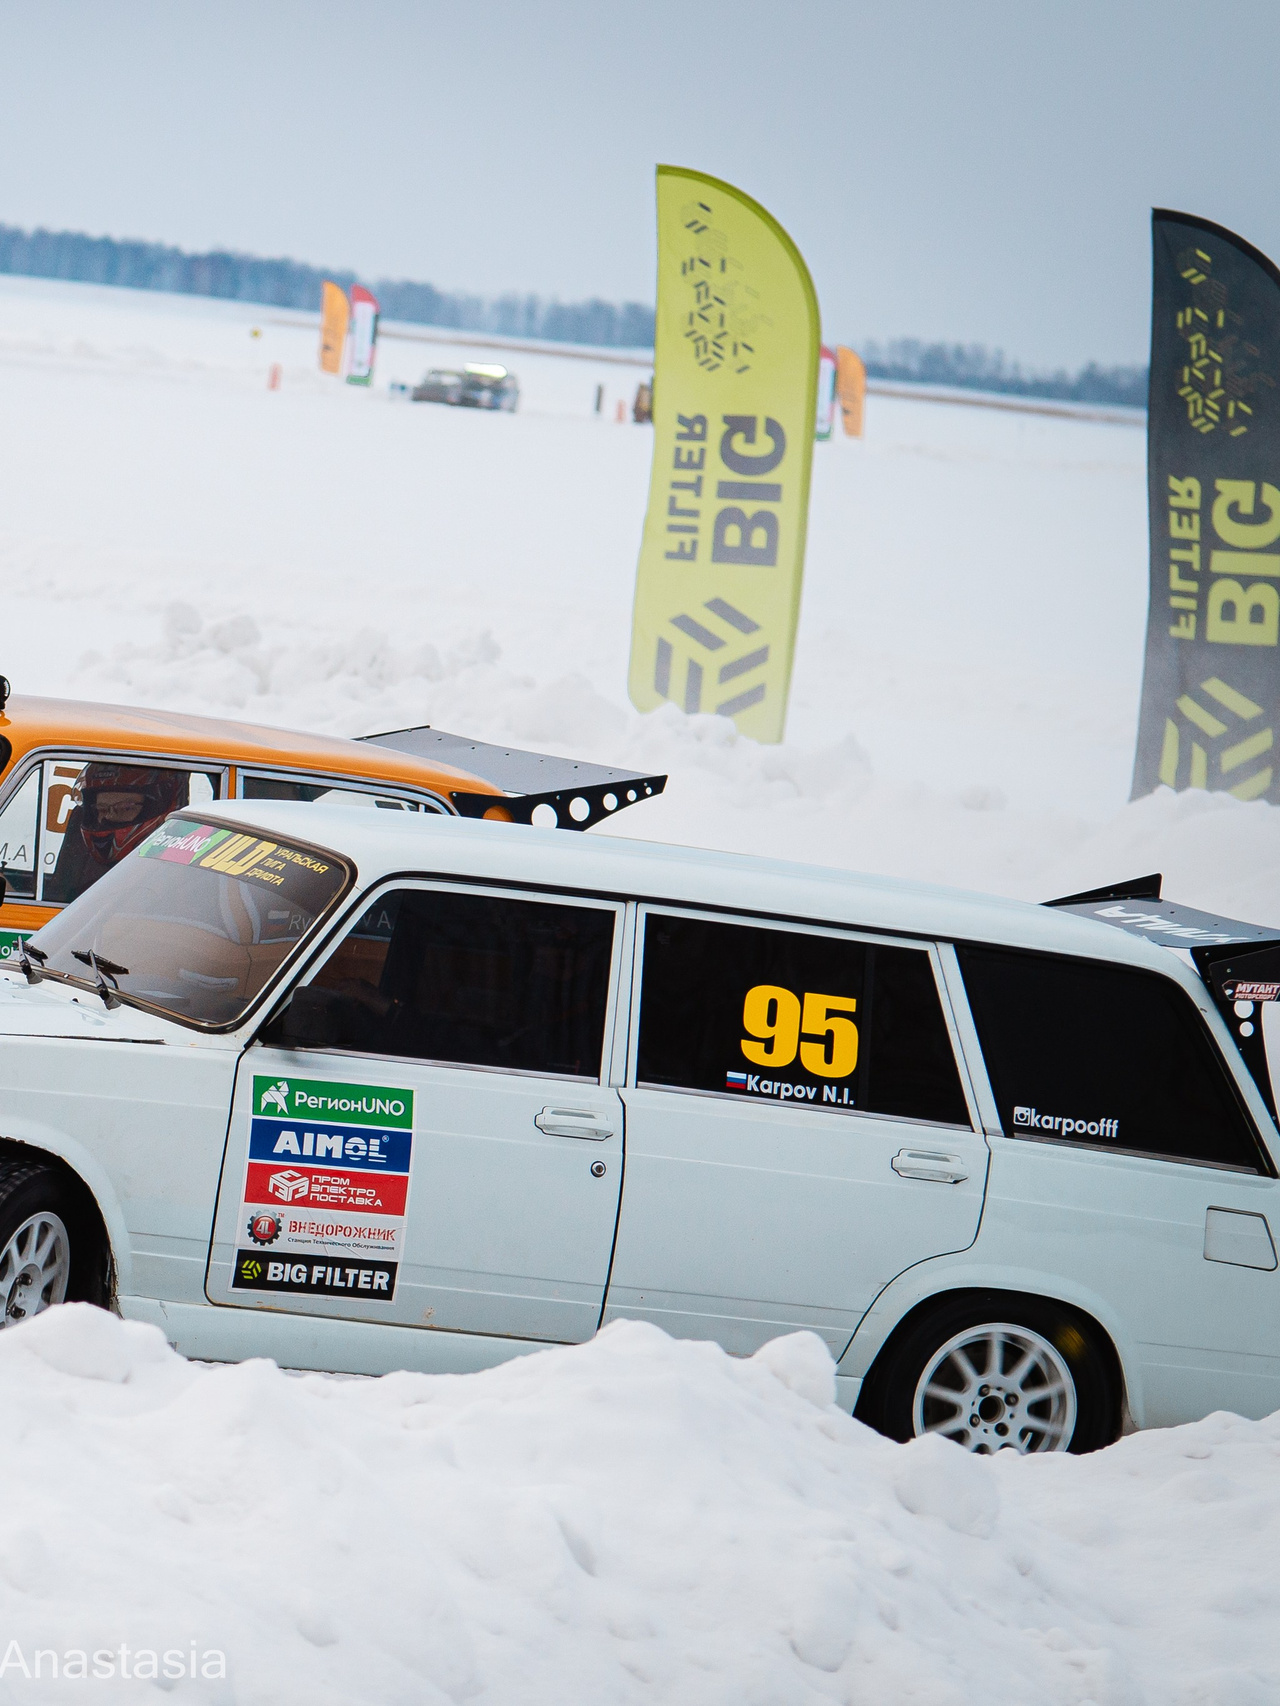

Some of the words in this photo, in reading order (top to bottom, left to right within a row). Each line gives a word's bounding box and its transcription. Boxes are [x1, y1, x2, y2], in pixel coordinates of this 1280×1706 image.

[260, 857, 287, 871] ЛИГА
[274, 848, 329, 874] УРАЛЬСКАЯ
[244, 867, 285, 886] ДРИФТА
[1235, 983, 1280, 994] МУТАНТ
[740, 984, 859, 1079] 95
[747, 1074, 818, 1100] Karpov
[823, 1085, 855, 1105] N.I.
[295, 1091, 405, 1116] РегионUNO
[1030, 1108, 1119, 1138] karpoofff
[272, 1130, 388, 1163] AIMOL
[311, 1184, 376, 1197] ЭЛЕКТРО
[312, 1175, 350, 1186] ПРОМ
[310, 1193, 382, 1207] ПОСТАВКА
[256, 1221, 271, 1235] 4L
[289, 1220, 396, 1241] ВНЕДОРОЖНИК
[313, 1238, 351, 1248] Технического
[352, 1242, 395, 1250] Обслуживания
[267, 1262, 308, 1284] BIG
[311, 1266, 390, 1291] FILTER
